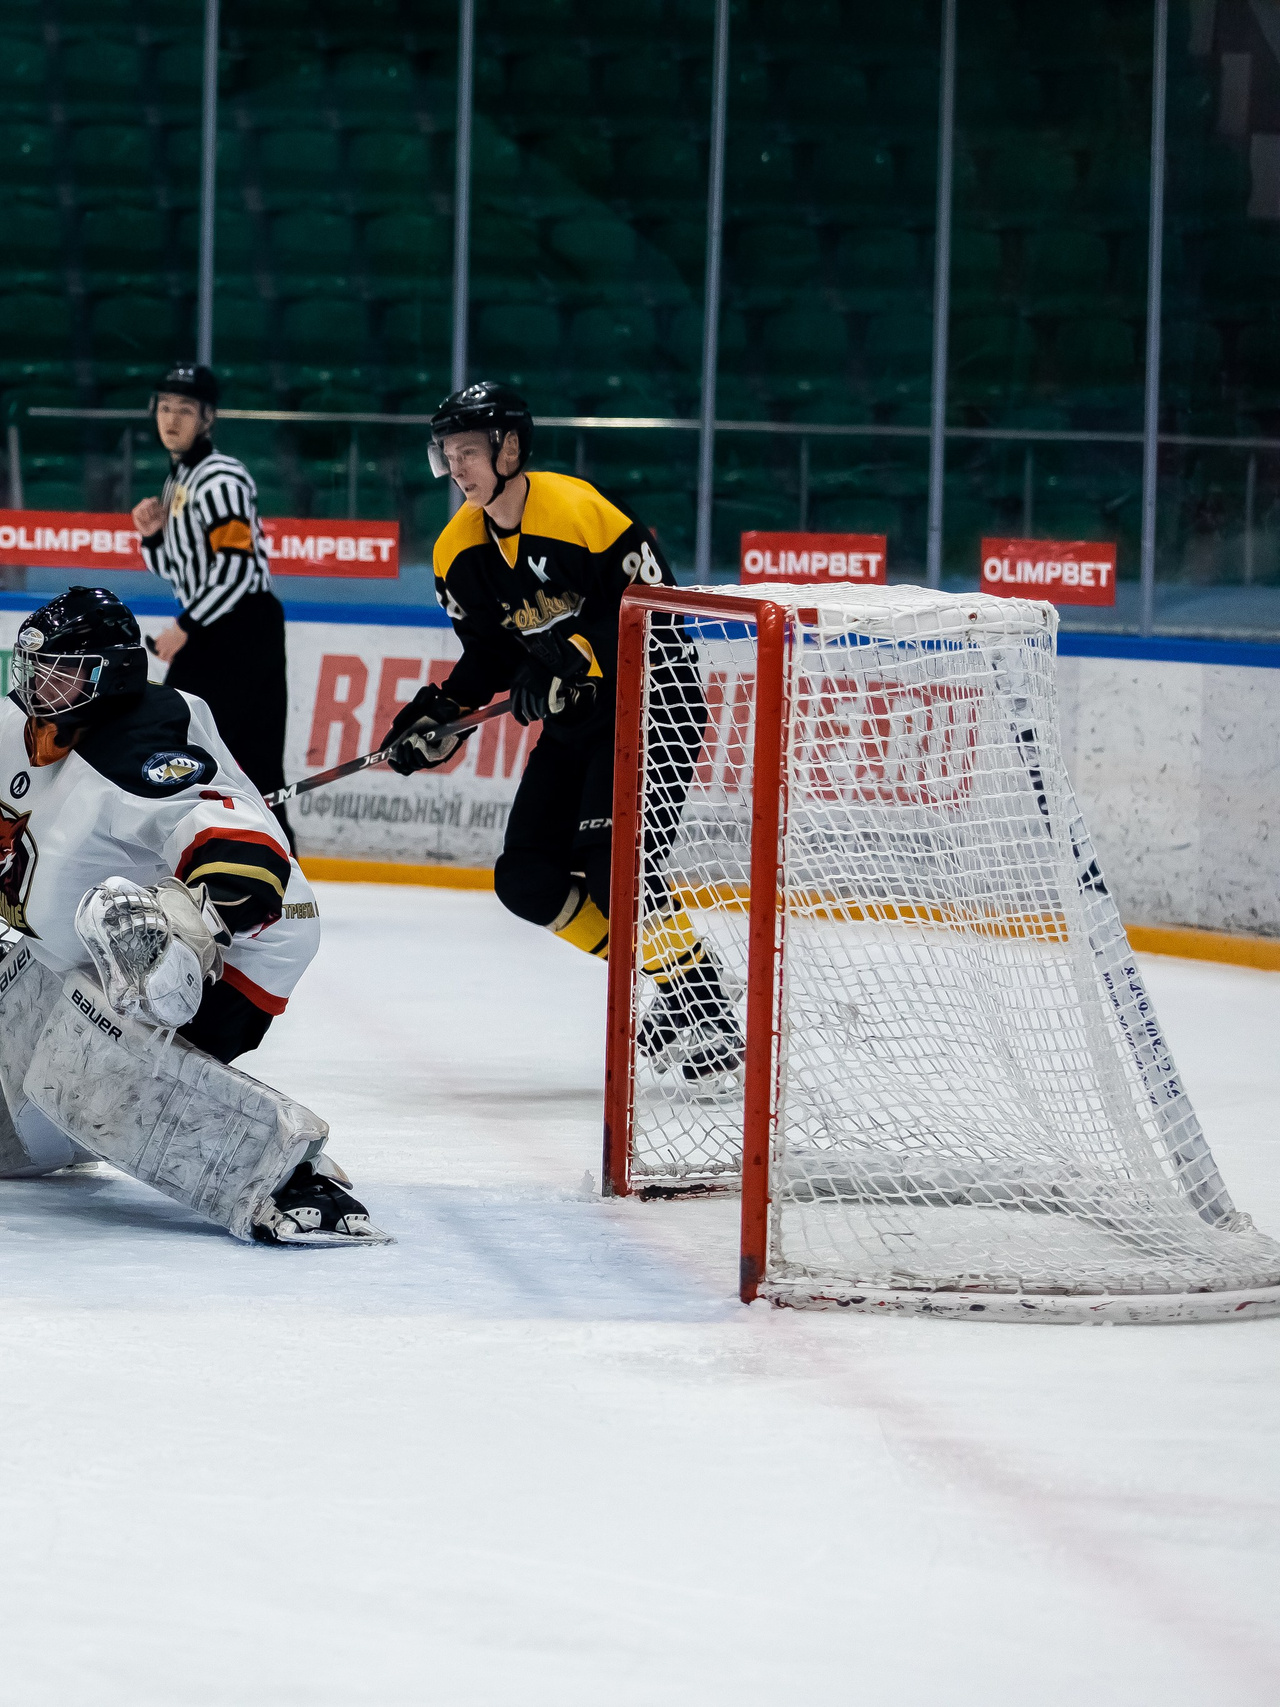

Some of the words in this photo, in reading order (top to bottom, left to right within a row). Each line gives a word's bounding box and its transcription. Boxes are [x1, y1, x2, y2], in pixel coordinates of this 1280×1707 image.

[258, 535, 396, 563] LIMPBET
[743, 548, 883, 578] OLIMPBET
[982, 556, 1112, 588] OLIMPBET
[70, 988, 123, 1043] BAUER
